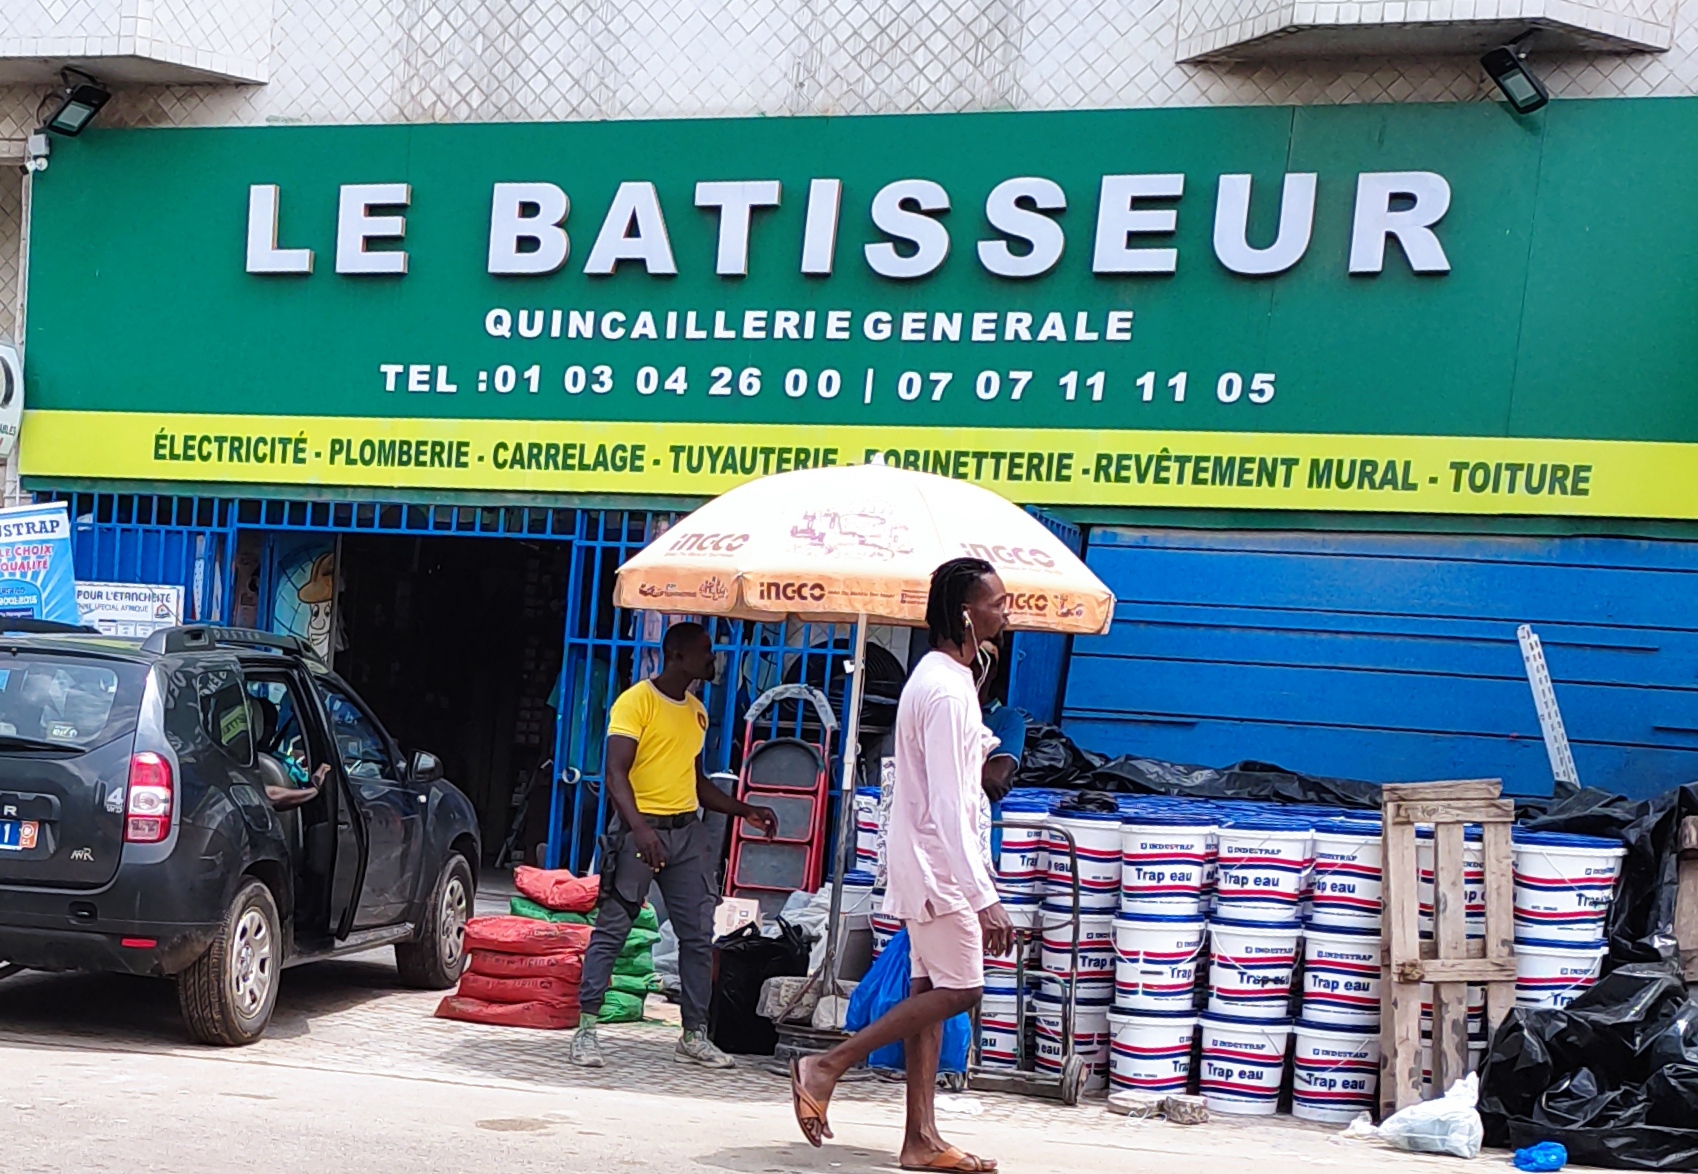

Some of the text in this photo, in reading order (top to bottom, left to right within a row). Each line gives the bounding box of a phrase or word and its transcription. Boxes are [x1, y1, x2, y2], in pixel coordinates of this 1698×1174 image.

[246, 172, 1452, 278] LE BATISSEUR
[486, 309, 1135, 343] QUINCAILLERIE GENERALE
[380, 364, 458, 394] TEL
[565, 366, 614, 395] 03
[636, 366, 689, 396] 04
[709, 367, 763, 397] 26
[785, 369, 842, 399] 00
[898, 371, 954, 402] 07
[977, 371, 1034, 401] 07
[1060, 371, 1106, 402] 11
[1137, 372, 1188, 403] 11
[1217, 373, 1277, 405] 05
[154, 427, 307, 465] ÉLECTRICITÉ
[330, 439, 471, 469] PLOMBERIE
[493, 442, 647, 473] CARRELAGE
[1308, 459, 1419, 492] MURAL
[1450, 463, 1593, 497] TOITURE
[0, 520, 60, 538] STRAP
[14, 545, 52, 557] CHOIX
[77, 590, 103, 602] POUR
